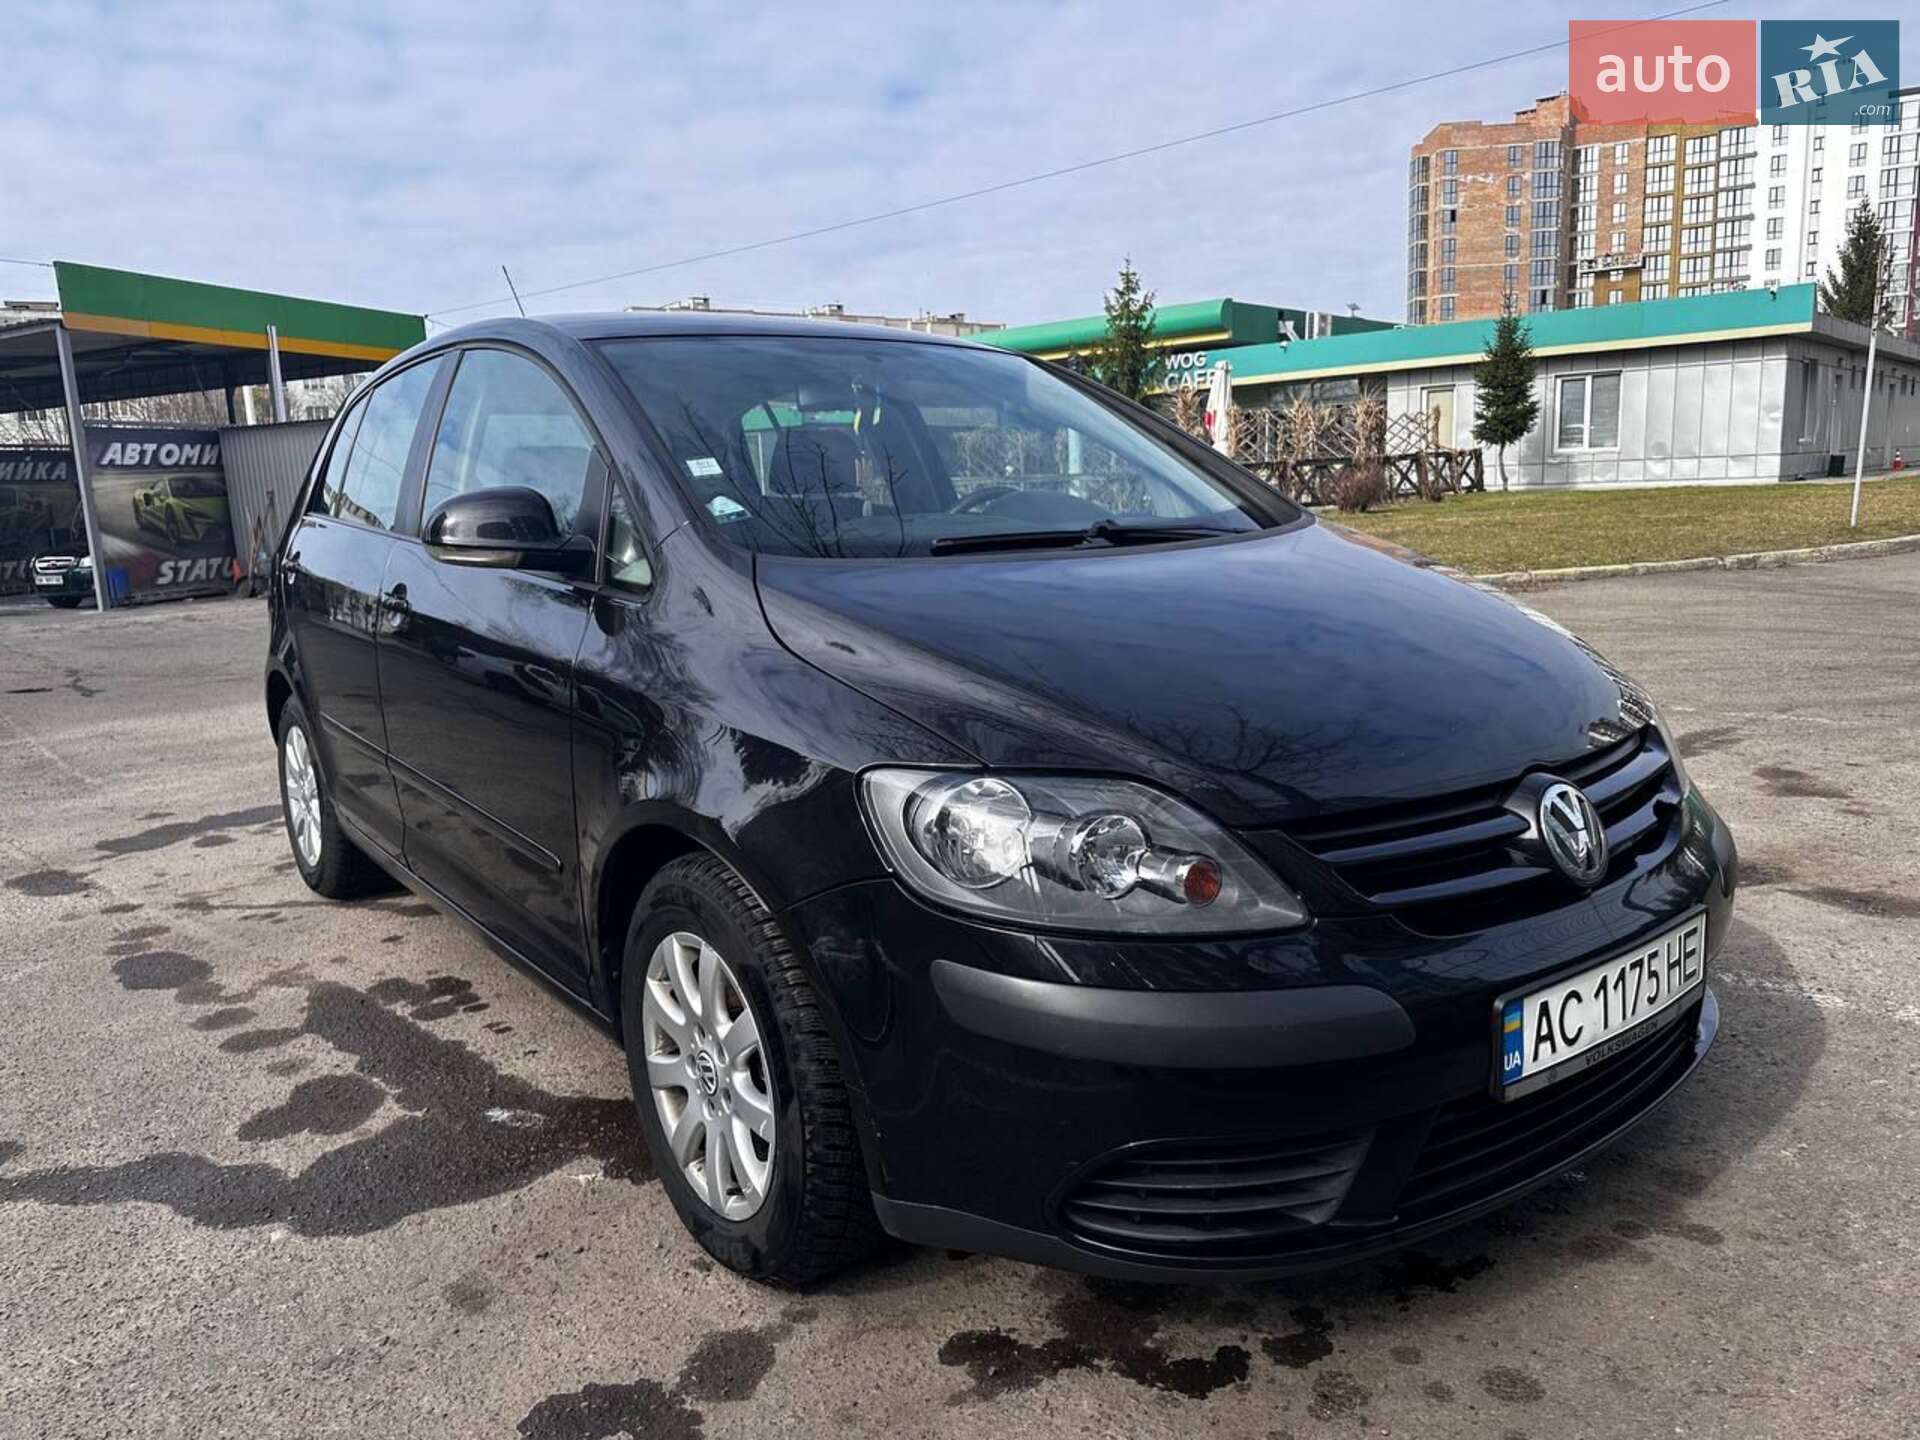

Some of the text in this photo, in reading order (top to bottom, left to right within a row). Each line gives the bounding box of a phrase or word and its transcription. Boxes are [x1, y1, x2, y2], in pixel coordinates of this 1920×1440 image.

[1164, 351, 1208, 370] WOG
[1532, 926, 1698, 1063] AC 1175 HE
[1584, 1020, 1659, 1066] VOLKSWAGEN
[1503, 1053, 1522, 1071] UA
